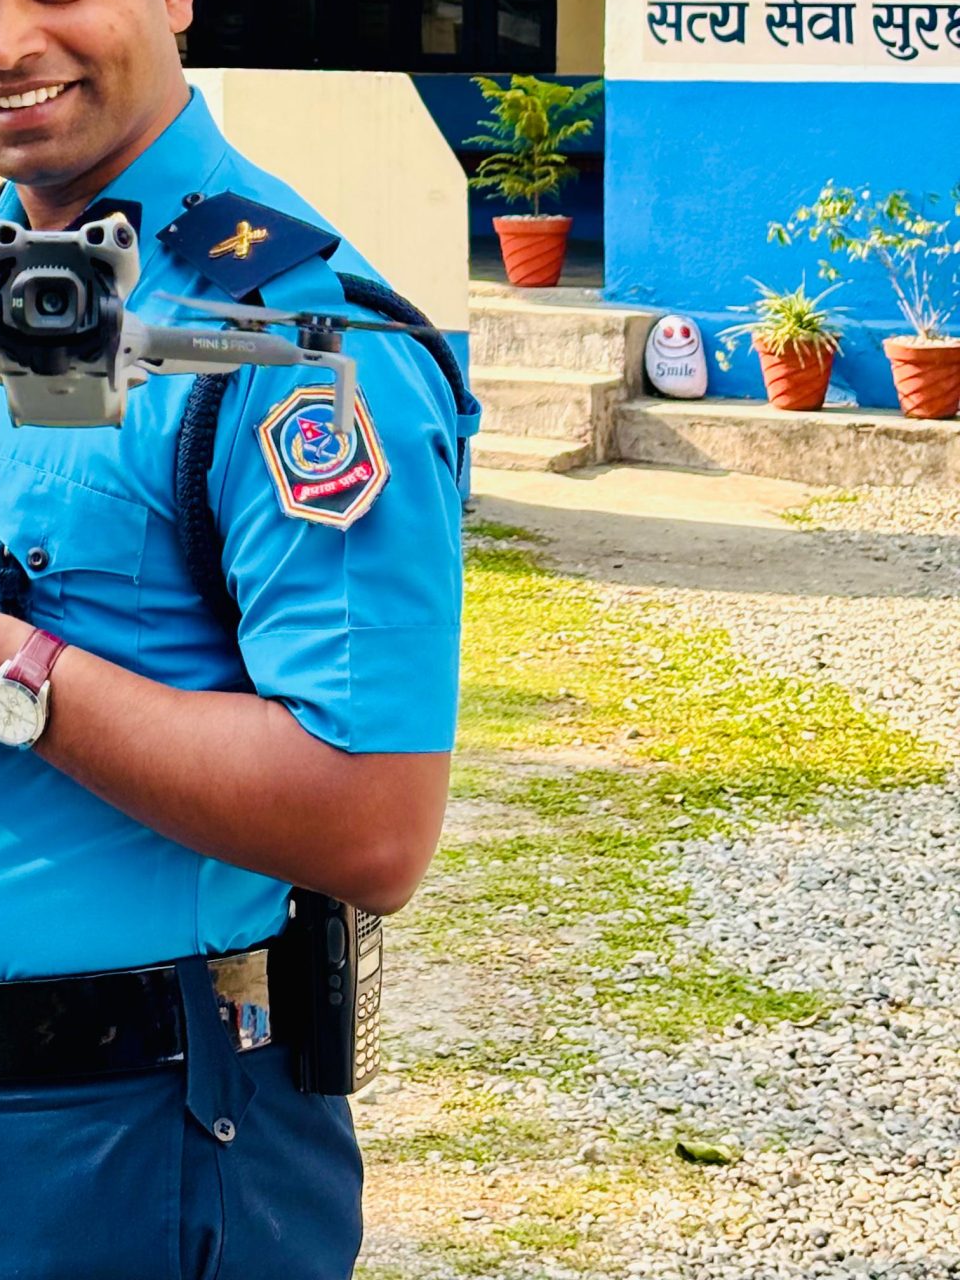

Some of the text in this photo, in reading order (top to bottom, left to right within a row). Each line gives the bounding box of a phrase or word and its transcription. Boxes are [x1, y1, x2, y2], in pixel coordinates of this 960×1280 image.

[647, 1, 749, 45] सत्य
[192, 337, 219, 349] MINI
[230, 339, 256, 352] PRO
[656, 361, 696, 378] Smile
